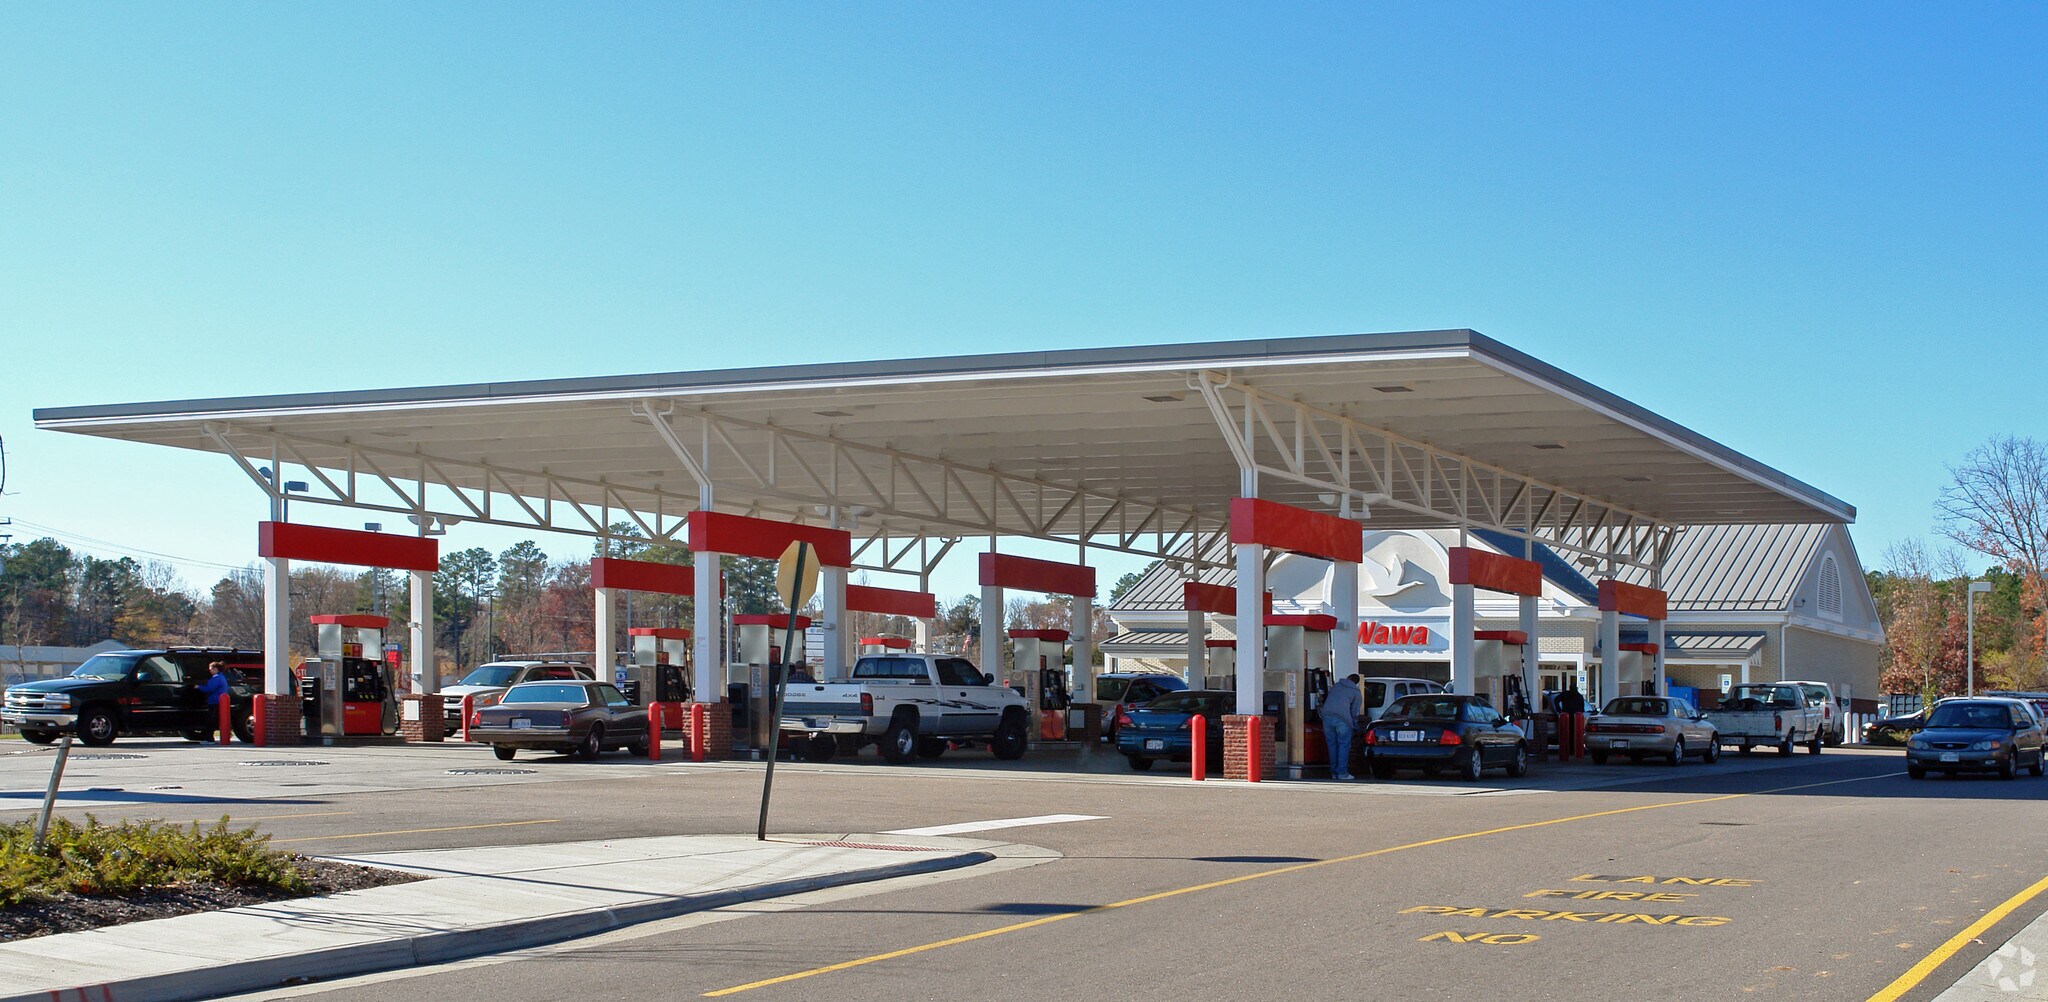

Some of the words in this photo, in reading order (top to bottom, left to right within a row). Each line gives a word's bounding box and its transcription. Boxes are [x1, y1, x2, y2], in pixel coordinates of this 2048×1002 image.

[1357, 621, 1428, 645] Wawa
[296, 668, 306, 676] ST
[1567, 874, 1764, 887] LANE
[1521, 889, 1700, 902] FIRE
[1397, 905, 1733, 926] PARKING
[1416, 931, 1542, 945] NO
